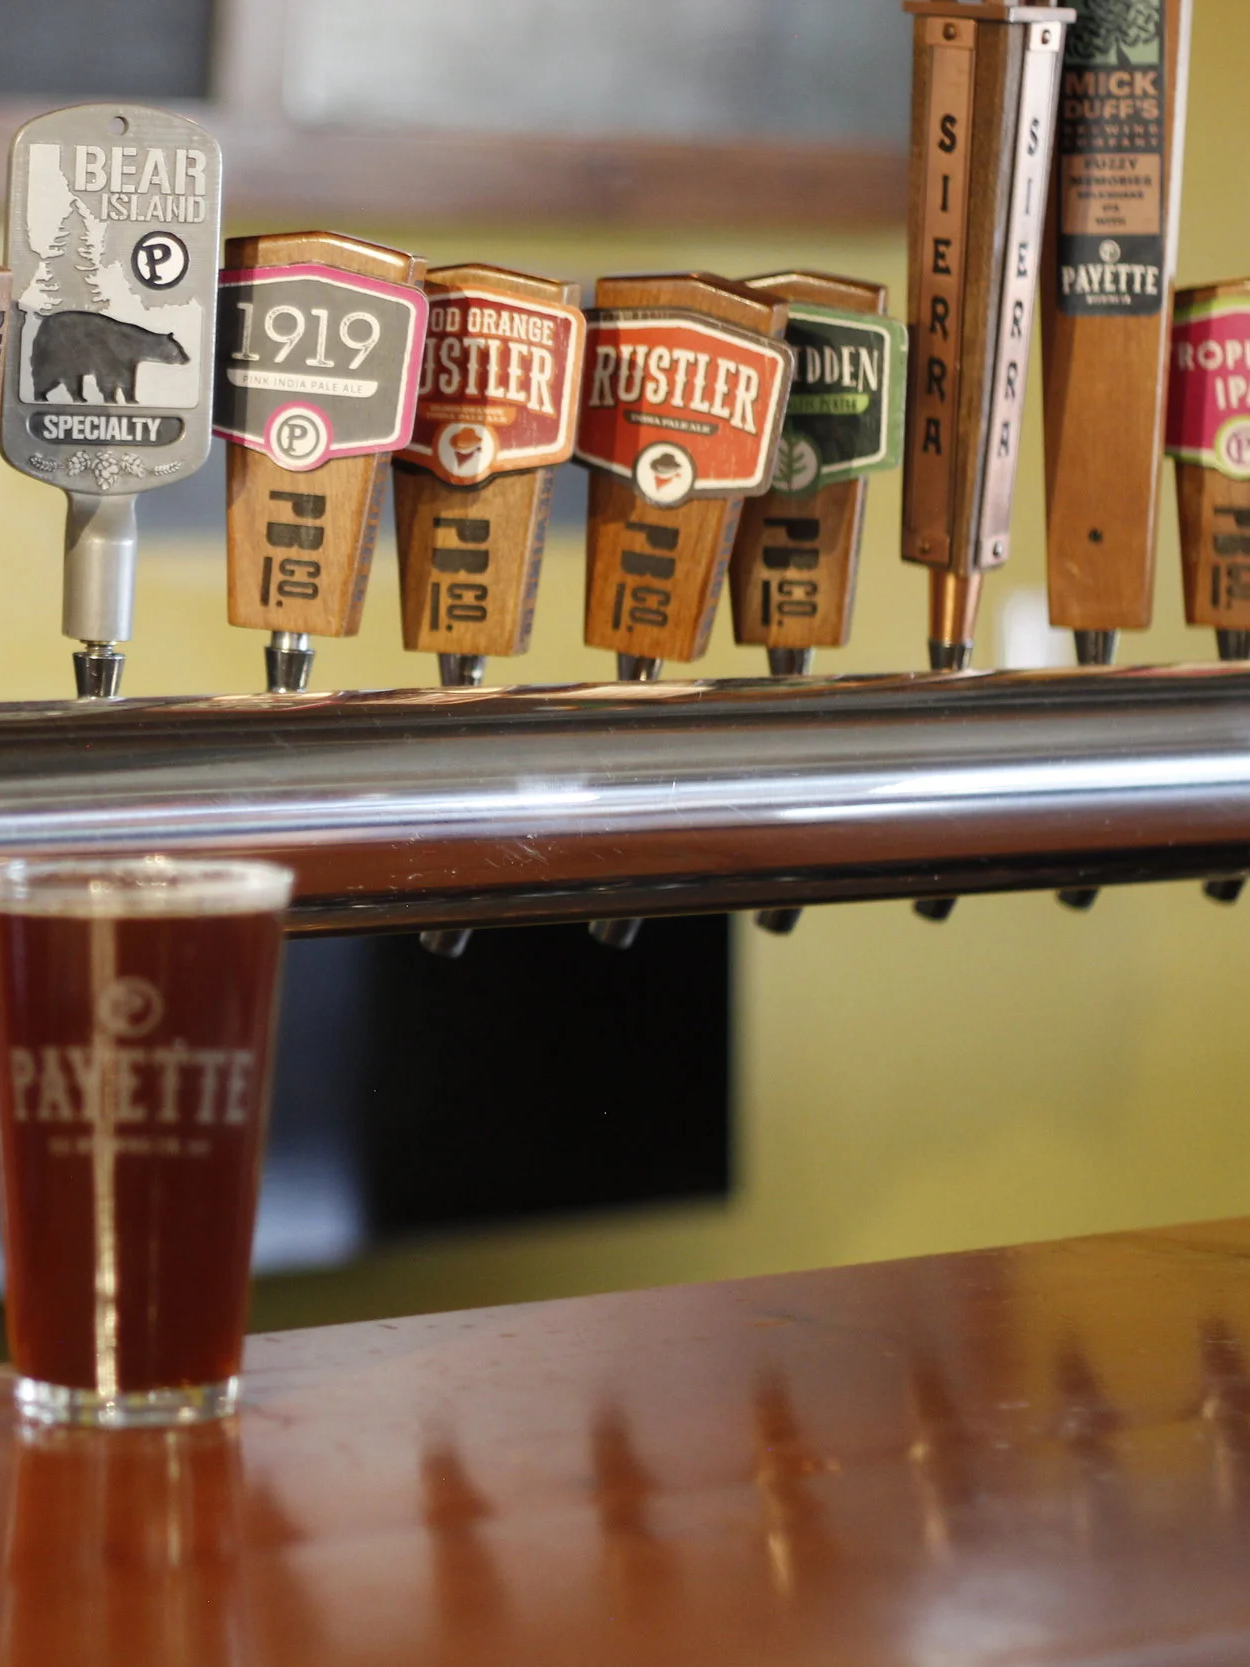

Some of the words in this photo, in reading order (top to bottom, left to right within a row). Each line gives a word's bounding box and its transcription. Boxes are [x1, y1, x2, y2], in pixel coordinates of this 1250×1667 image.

[1065, 71, 1159, 96] MICK
[1064, 99, 1159, 120] DUFF'S
[74, 144, 207, 196] BEAR
[100, 193, 206, 224] ISLAND
[922, 113, 957, 455] SIERRA
[1061, 262, 1160, 296] PAYETTE
[231, 302, 380, 370] 1919
[467, 307, 555, 346] ORANGE
[242, 374, 269, 385] PINK
[273, 378, 307, 390] INDIA
[311, 381, 338, 393] PALE
[342, 384, 363, 395] ALE
[419, 336, 556, 415] USTLER
[588, 344, 759, 435] RUSTLER
[43, 415, 162, 442] SPECIALTY
[8, 1044, 254, 1125] PAYETTE
